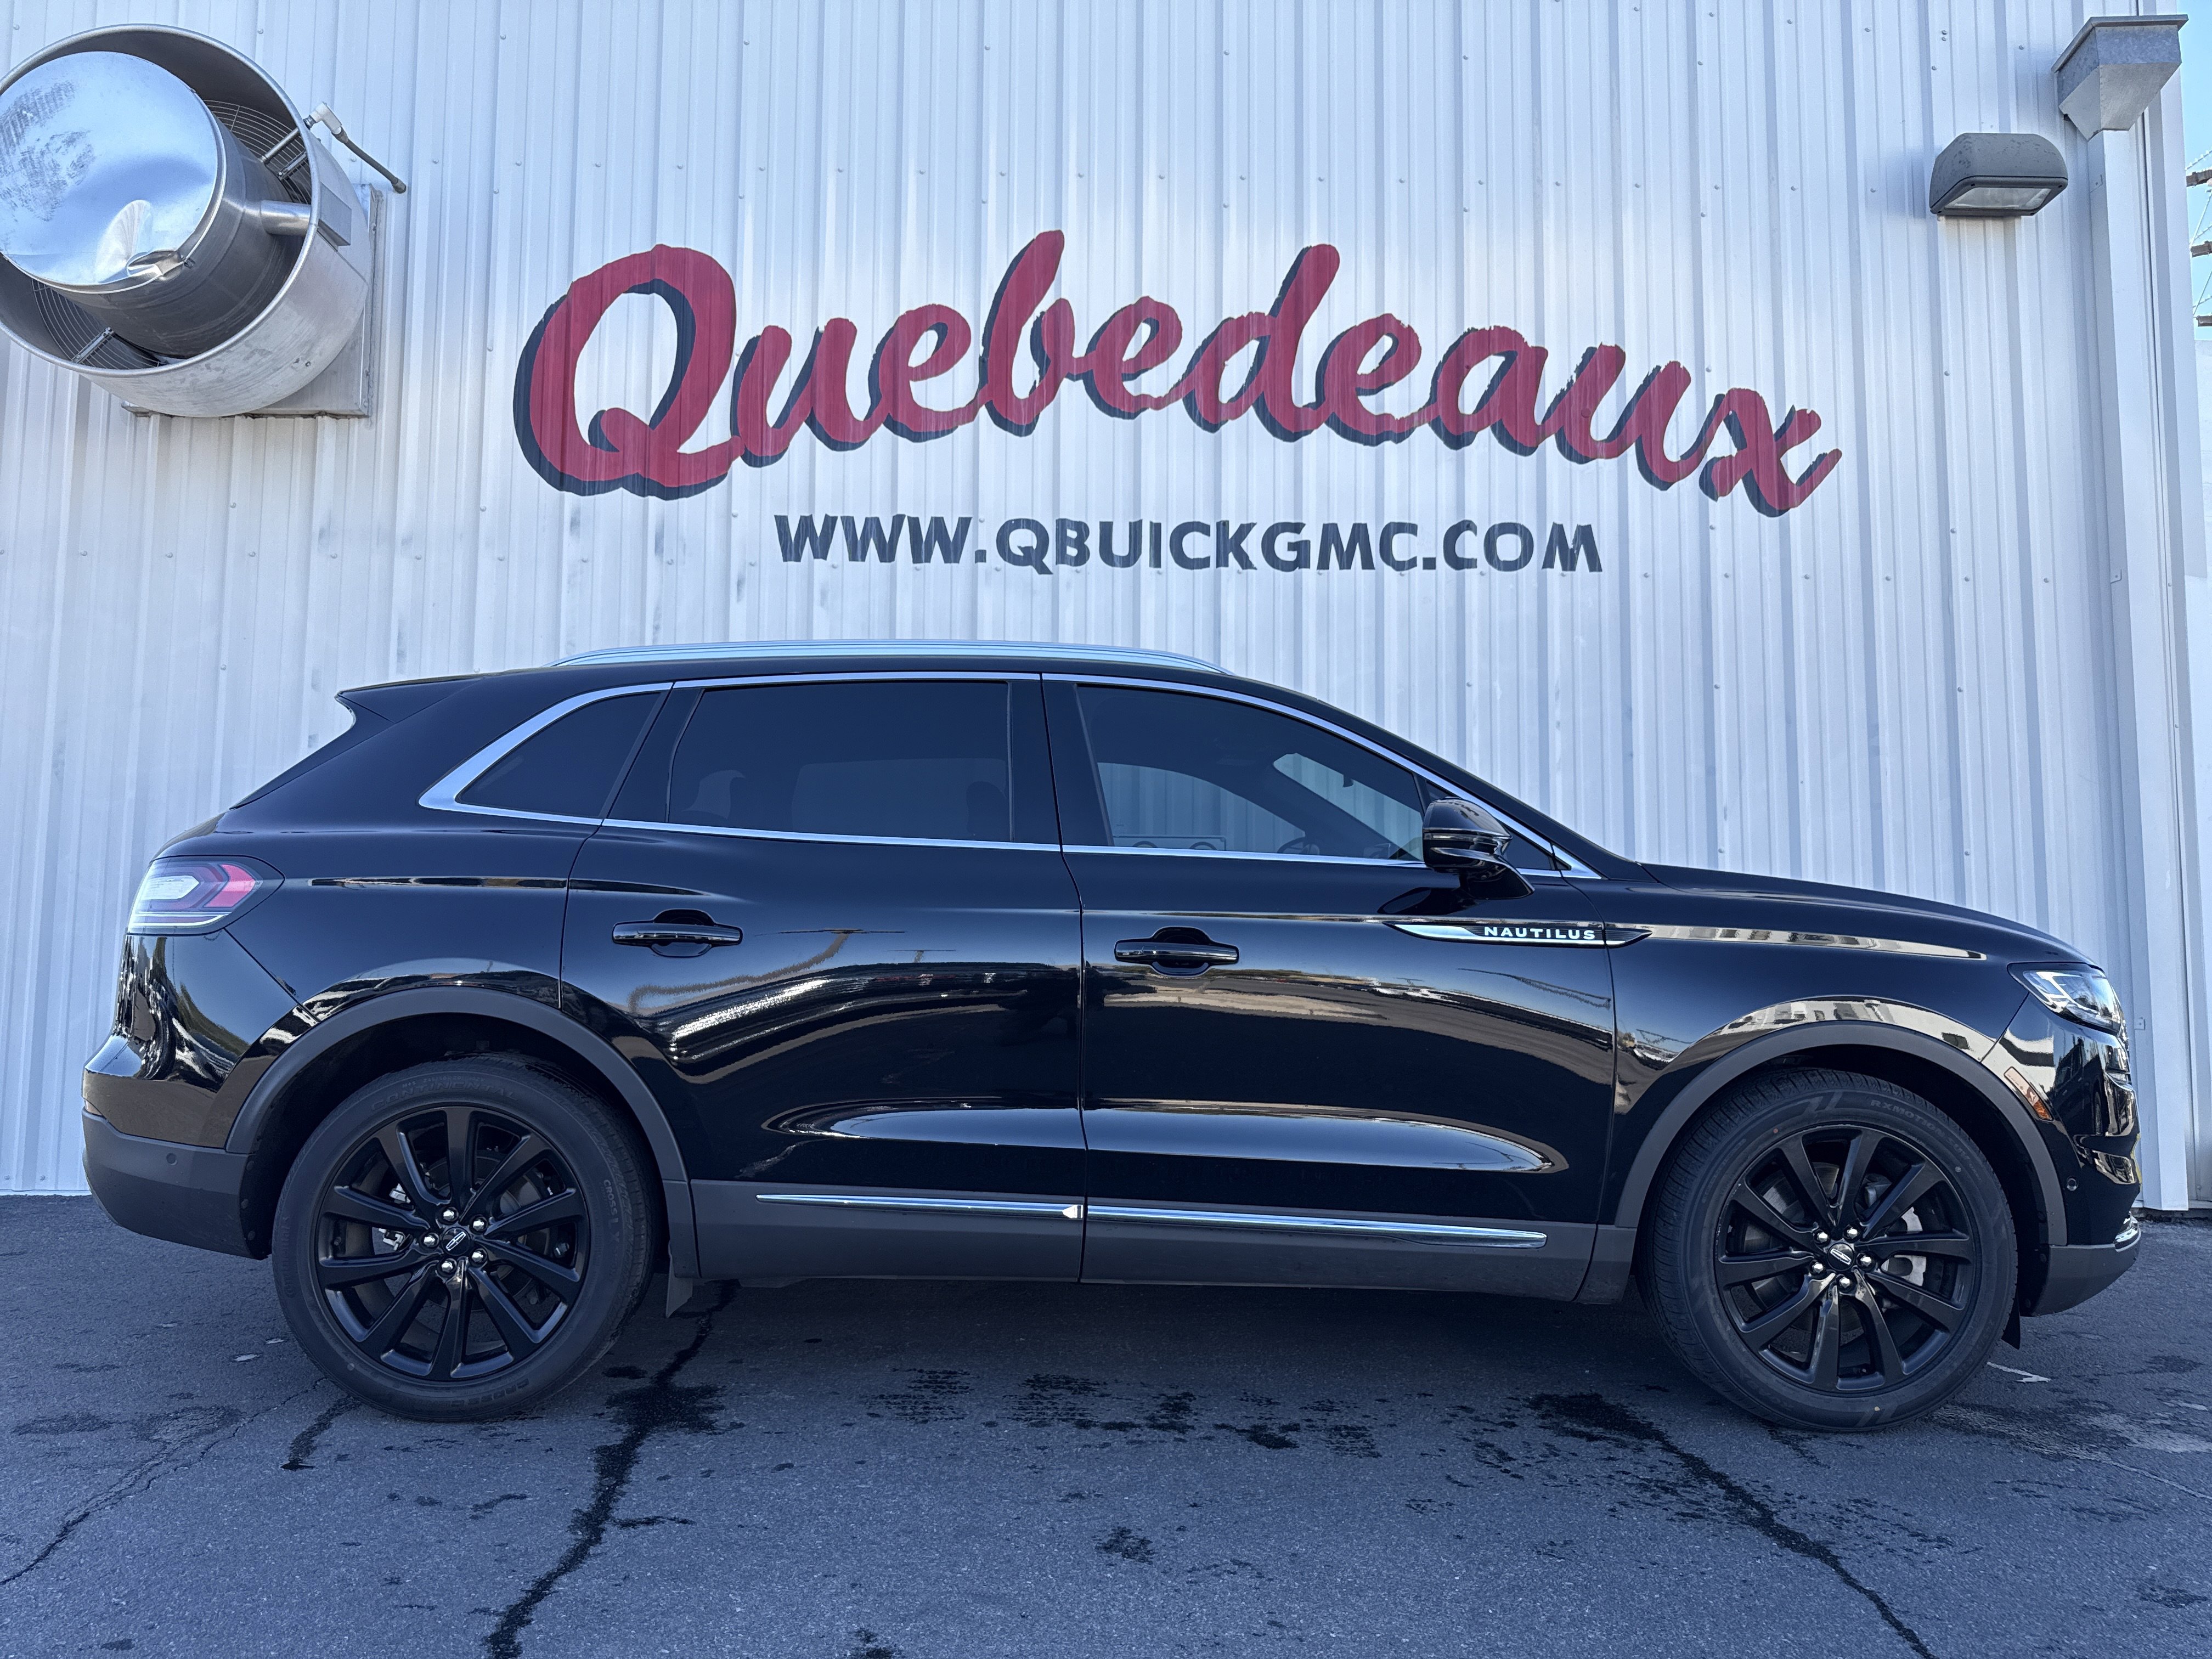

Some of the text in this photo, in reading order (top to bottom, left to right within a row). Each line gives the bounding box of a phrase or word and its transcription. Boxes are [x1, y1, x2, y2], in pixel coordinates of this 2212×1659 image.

[515, 230, 1842, 517] Quebedeaux
[774, 514, 1603, 573] WWW.QBUICKGMC.COM
[1484, 926, 1595, 940] NAUTILUS
[603, 1180, 618, 1215] CROSS
